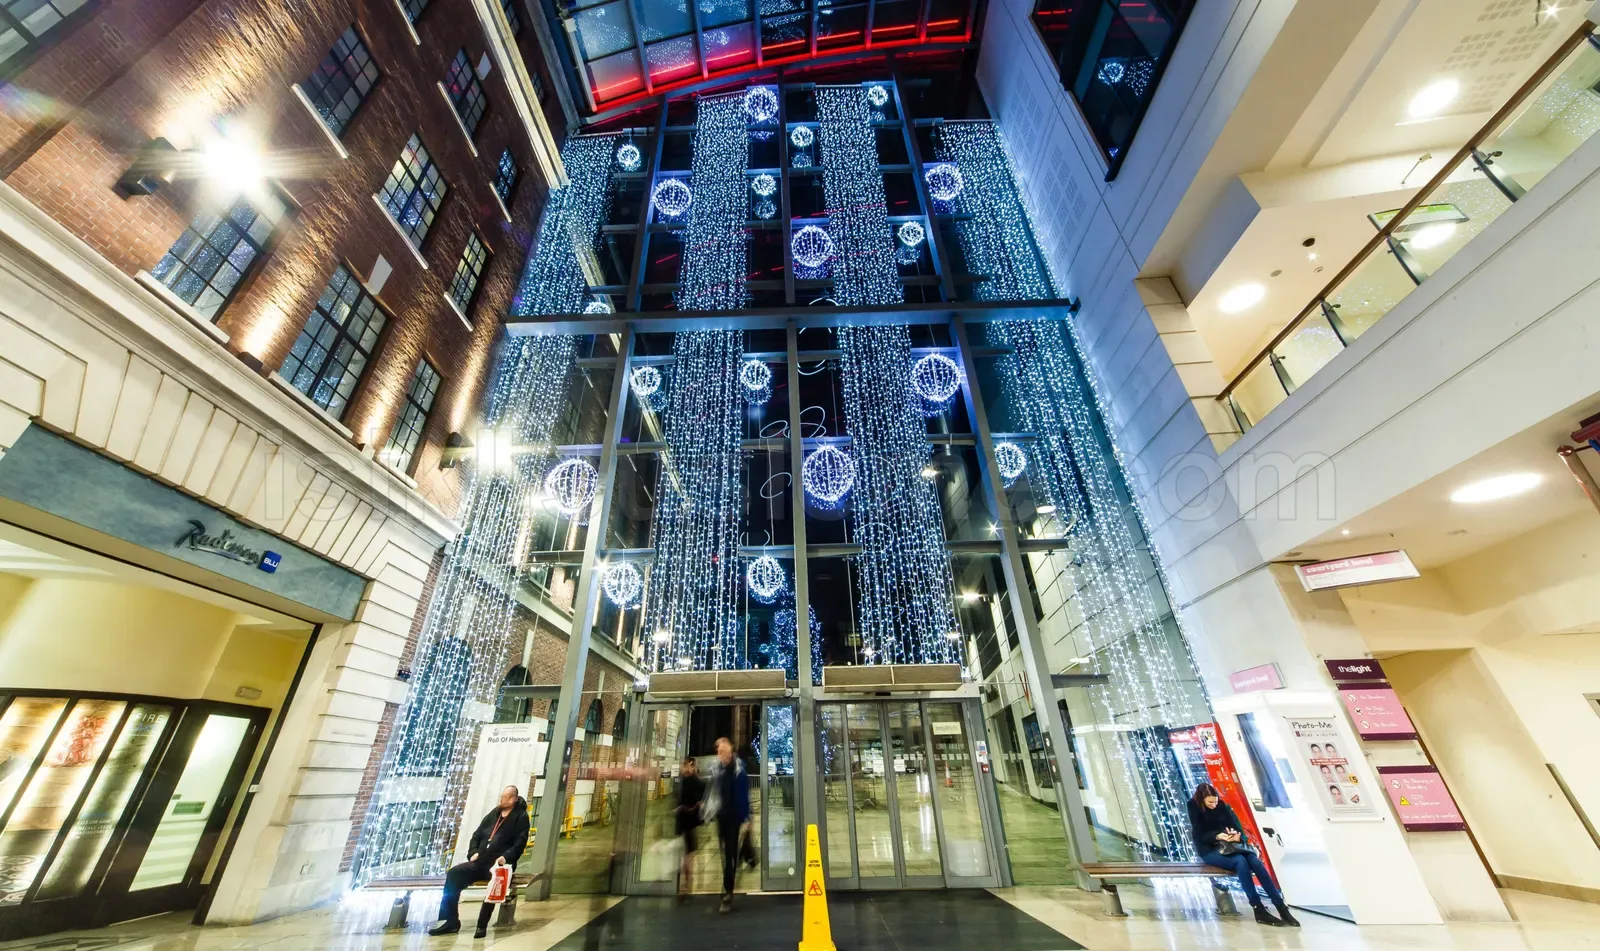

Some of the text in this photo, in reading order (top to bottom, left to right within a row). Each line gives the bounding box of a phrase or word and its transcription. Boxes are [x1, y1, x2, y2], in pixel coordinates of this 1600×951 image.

[263, 557, 279, 568] BLU
[134, 712, 164, 722] FIRE
[1291, 721, 1332, 729] Photo-Me
